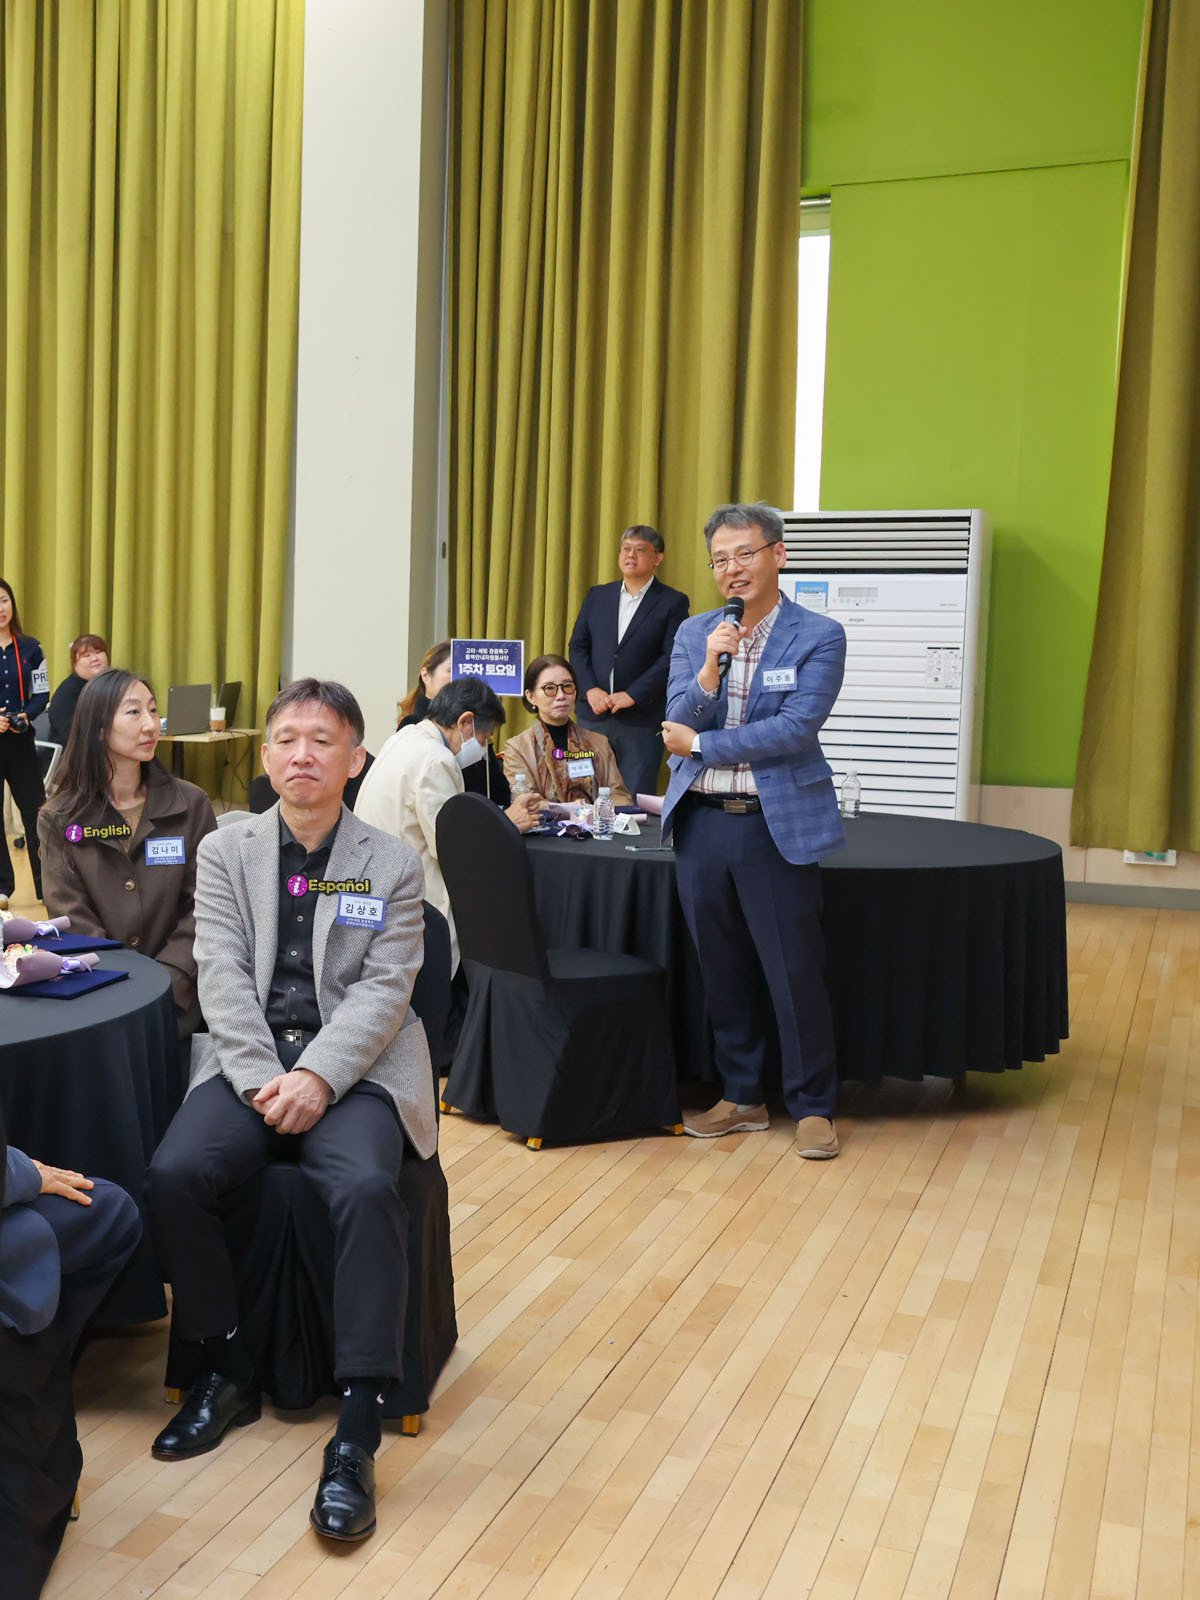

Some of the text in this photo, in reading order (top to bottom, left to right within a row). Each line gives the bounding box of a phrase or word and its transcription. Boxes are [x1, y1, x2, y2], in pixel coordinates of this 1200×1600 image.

[458, 663, 516, 677] 1주차 토요일
[563, 750, 595, 759] English
[83, 824, 131, 838] English
[151, 845, 179, 855] 김나미
[308, 879, 369, 894] Español
[345, 903, 378, 917] 김상호
